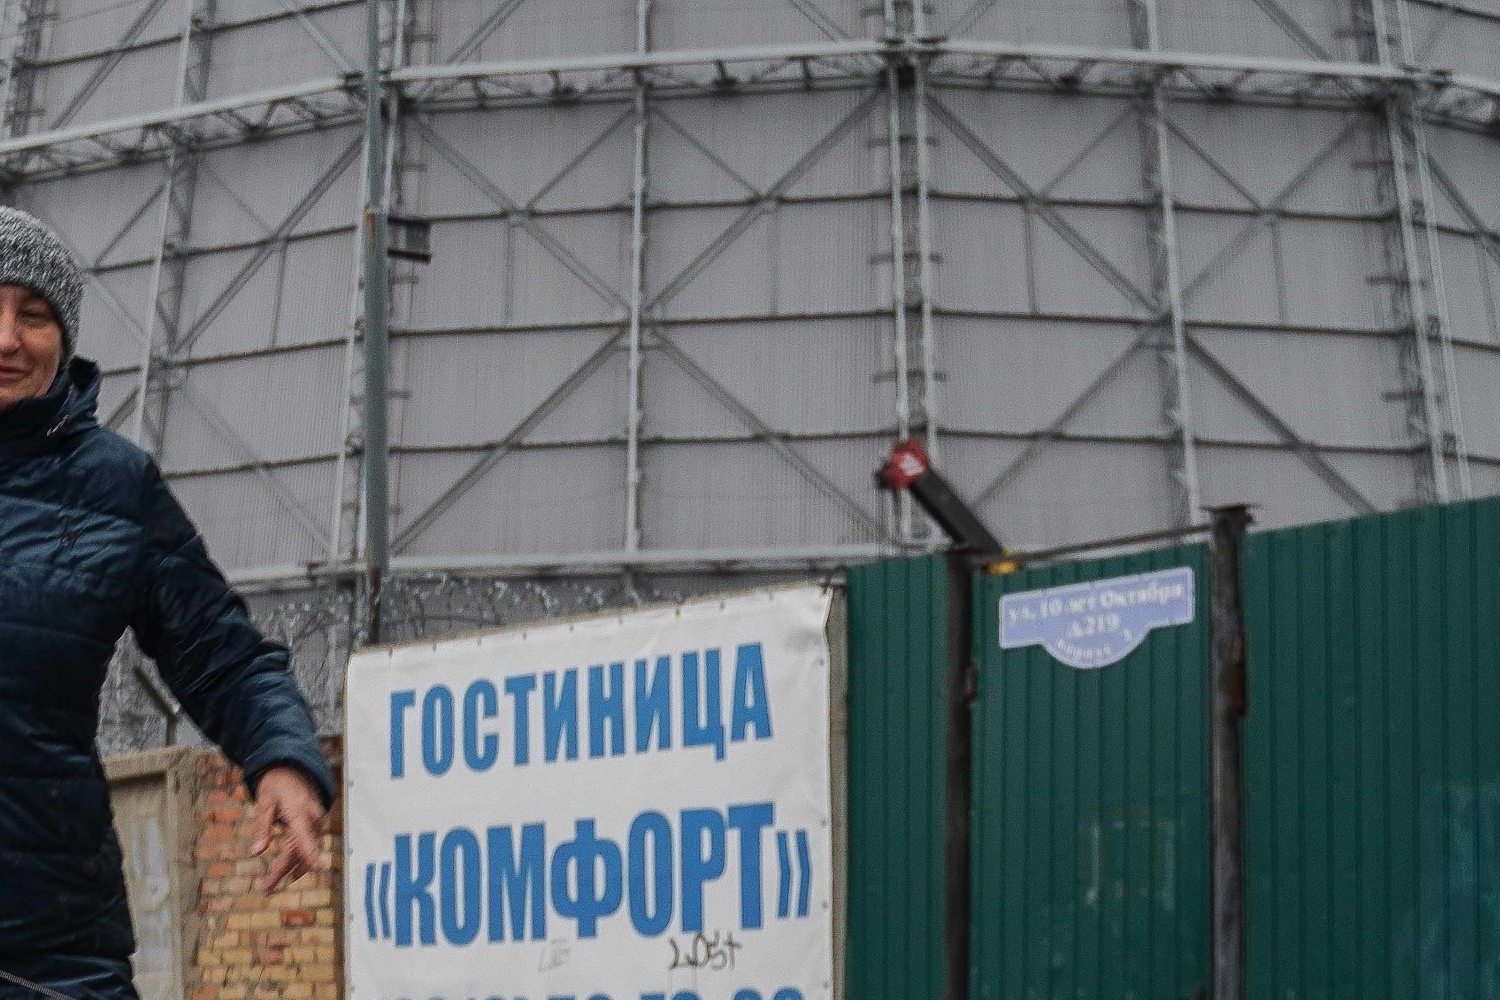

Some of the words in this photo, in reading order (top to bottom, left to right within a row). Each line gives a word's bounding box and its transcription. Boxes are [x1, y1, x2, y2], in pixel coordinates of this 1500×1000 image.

[1039, 599, 1063, 618] 10
[390, 642, 772, 779] ГОСТИНИЦА
[365, 801, 811, 947] «КОМФОРТ»
